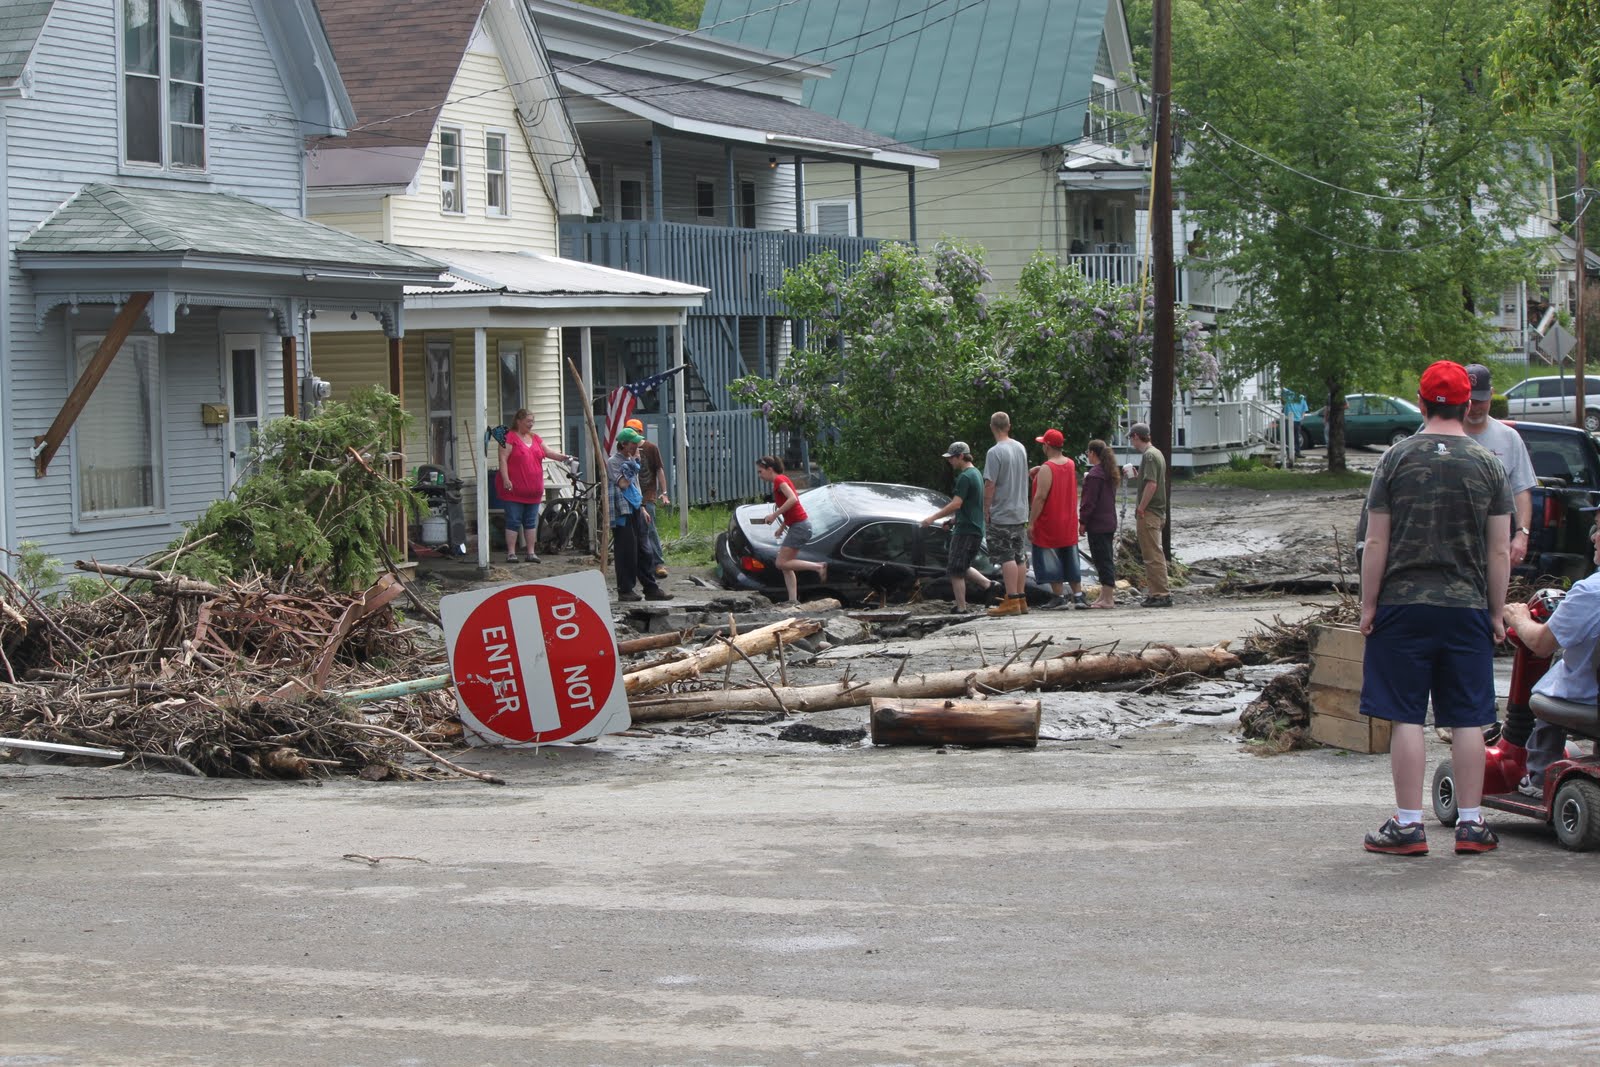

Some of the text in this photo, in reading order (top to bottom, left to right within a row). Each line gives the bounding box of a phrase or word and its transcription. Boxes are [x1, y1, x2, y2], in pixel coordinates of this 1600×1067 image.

[482, 626, 521, 714] ENTER
[551, 603, 595, 710] DO NOT
